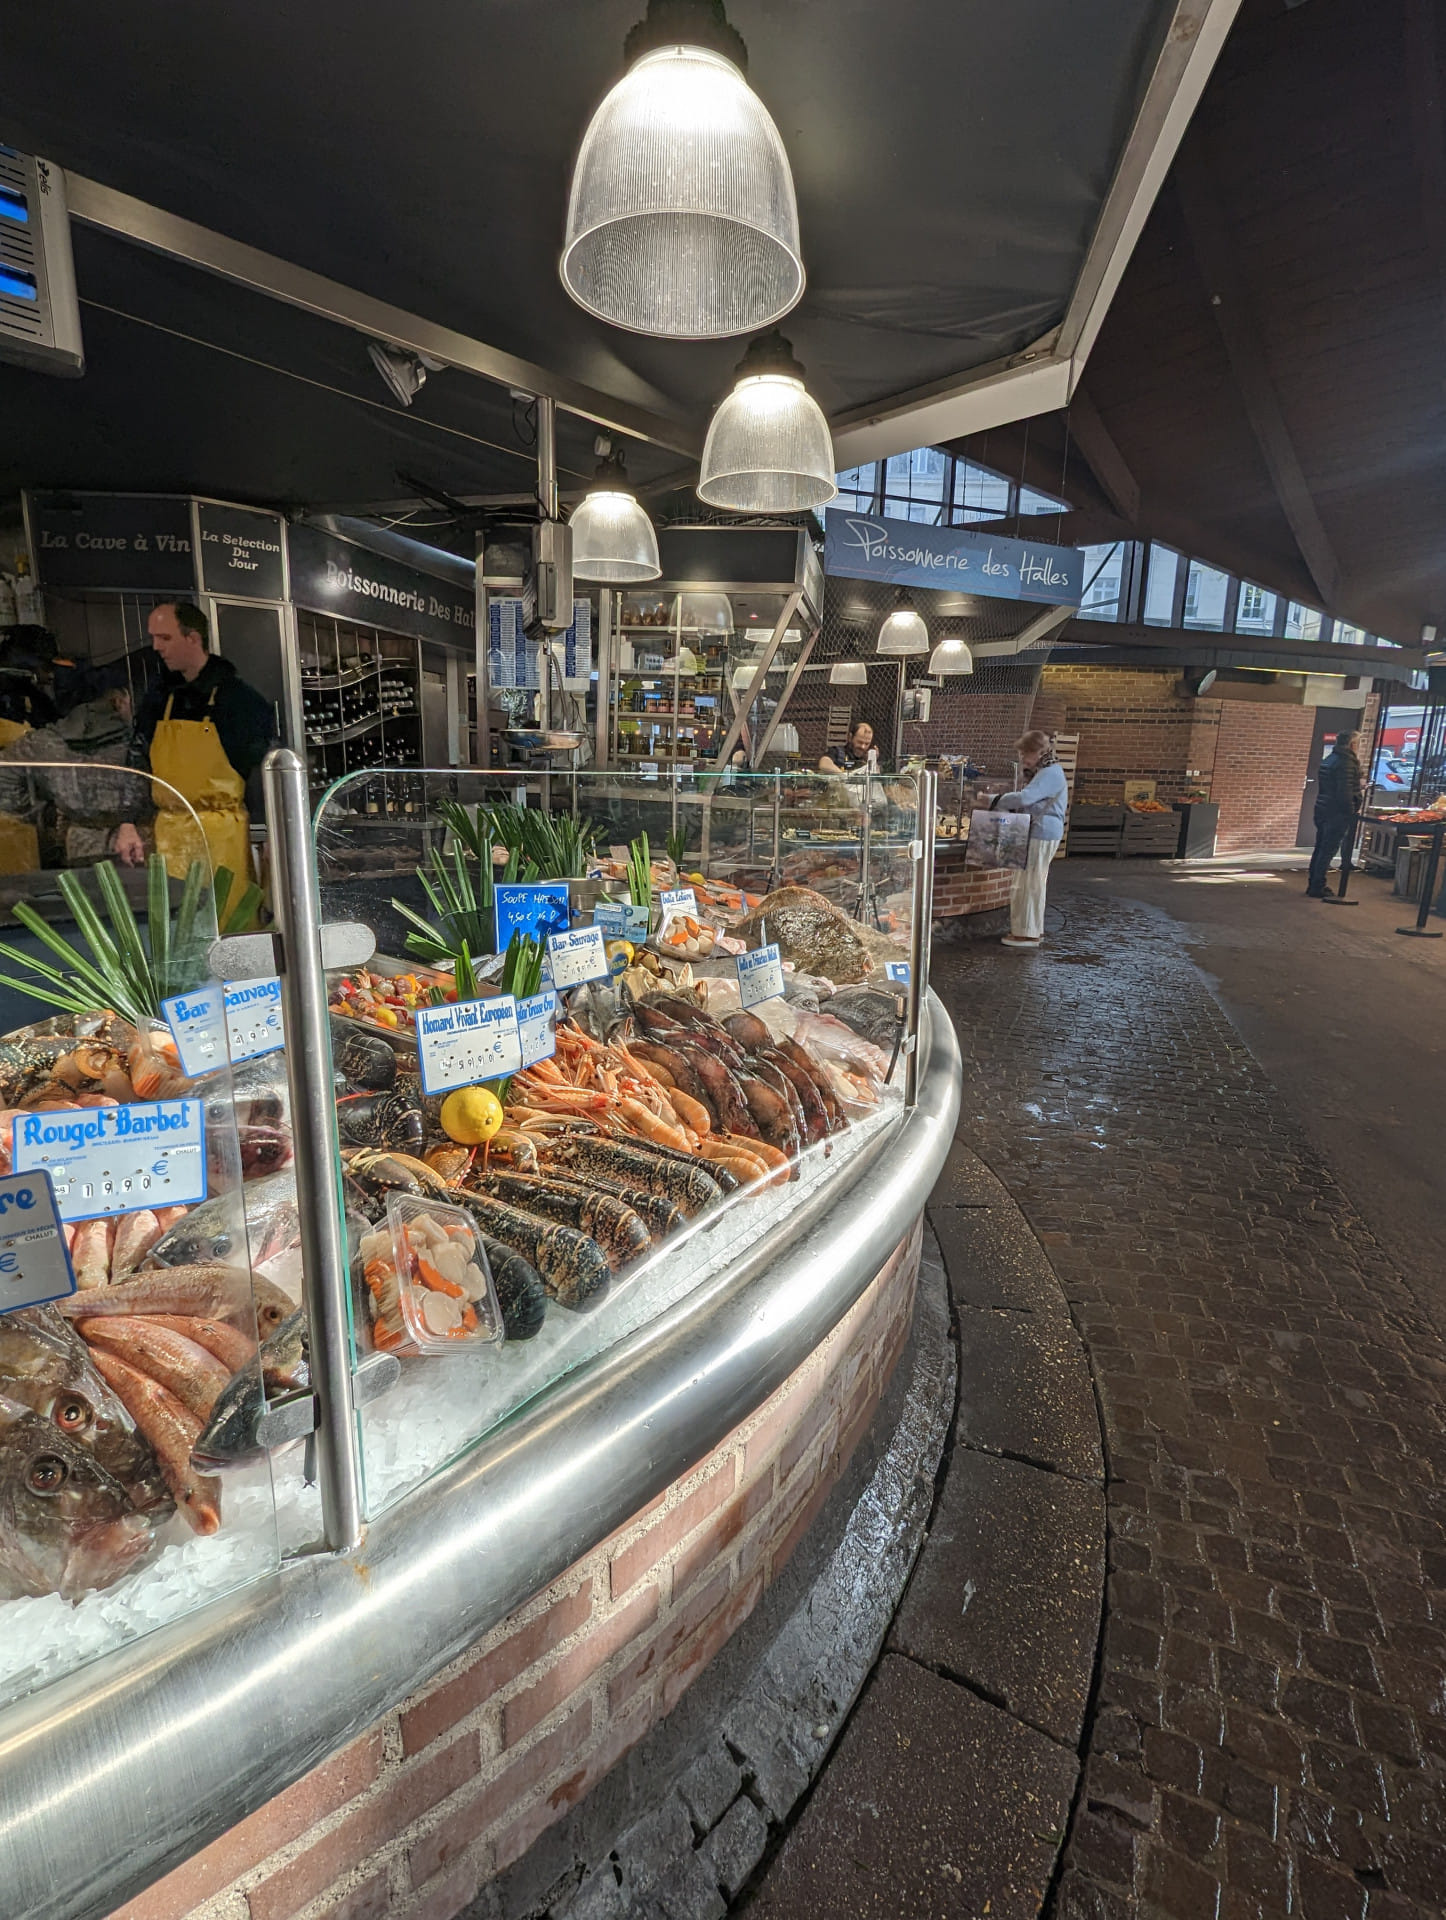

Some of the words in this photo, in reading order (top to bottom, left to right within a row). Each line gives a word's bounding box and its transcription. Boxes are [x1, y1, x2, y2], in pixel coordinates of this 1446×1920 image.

[41, 530, 69, 548] La
[75, 532, 127, 550] Cave
[134, 534, 149, 551] à
[155, 535, 191, 552] Vin
[202, 530, 219, 543] La
[223, 533, 281, 553] Selection
[232, 547, 250, 558] Du
[843, 519, 970, 570] Poissonnerie
[982, 548, 1009, 577] des
[1019, 551, 1069, 586] Halles
[228, 558, 259, 571] Jour
[326, 560, 425, 612] Poissonnerie
[428, 596, 450, 620] Des
[454, 604, 475, 629] Hal
[552, 937, 567, 951] Bar
[568, 932, 600, 947] Sauvage
[174, 1000, 211, 1023] Bar
[224, 980, 281, 1008] auvag
[266, 1014, 279, 1027] €
[422, 1012, 454, 1035] Homard
[454, 1004, 479, 1027] Vivant
[480, 1002, 514, 1027] Européen
[493, 1041, 503, 1053] €
[24, 1109, 107, 1150] Rouget
[115, 1103, 190, 1137] Barbet
[152, 1159, 169, 1176] €
[25, 1230, 54, 1241] CHALUT
[0, 1252, 19, 1273] €
